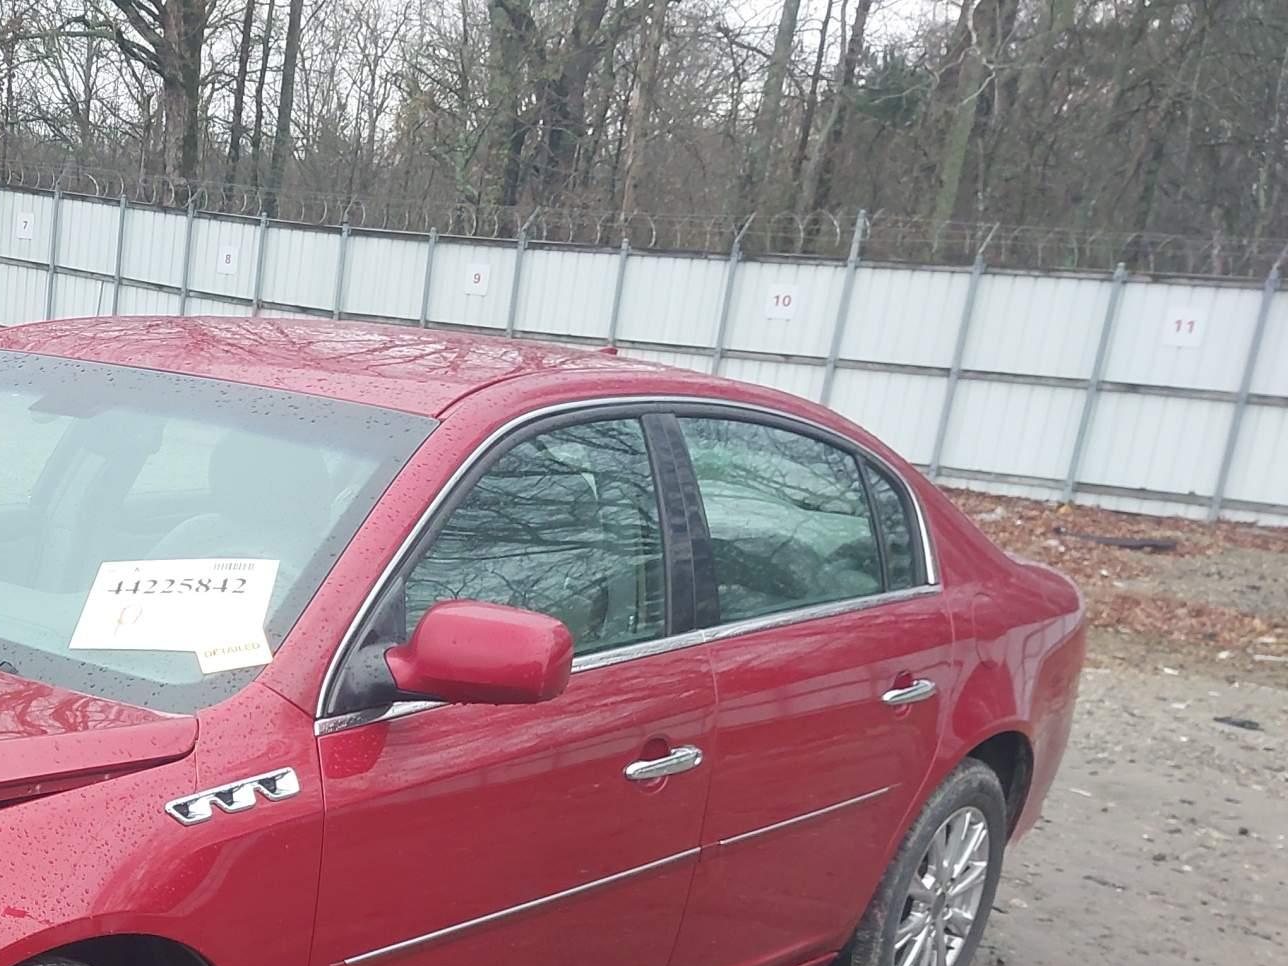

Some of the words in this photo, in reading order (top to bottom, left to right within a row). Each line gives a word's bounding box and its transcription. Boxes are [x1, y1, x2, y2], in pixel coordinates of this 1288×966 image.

[22, 220, 28, 230] 7
[224, 254, 231, 265] 8
[473, 273, 481, 284] 9
[774, 294, 792, 307] 10
[1175, 319, 1195, 334] 11
[107, 577, 247, 594] 44225842
